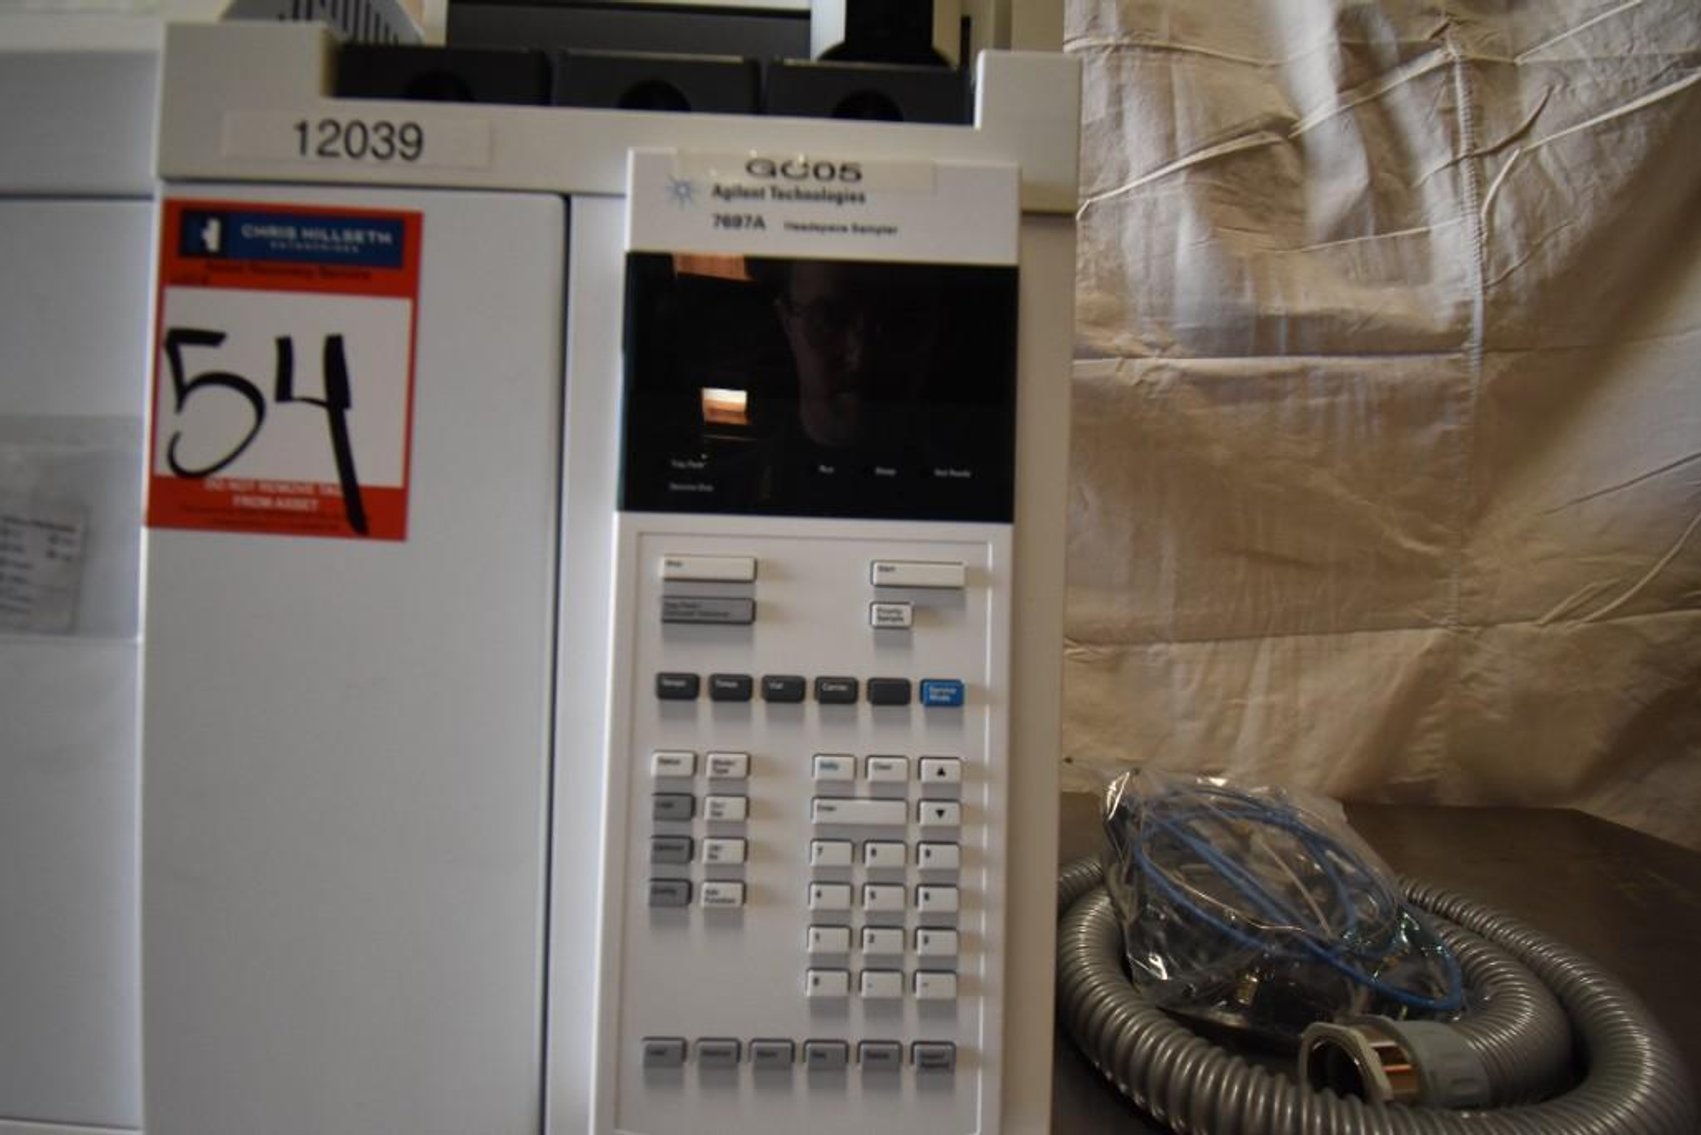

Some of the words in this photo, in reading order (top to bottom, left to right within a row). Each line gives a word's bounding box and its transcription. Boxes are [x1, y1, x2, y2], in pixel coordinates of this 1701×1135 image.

[294, 118, 424, 162] 12039
[745, 157, 863, 183] GC05
[712, 184, 766, 202] Agilent
[770, 186, 867, 205] Technologies
[240, 223, 297, 240] CHRIS
[163, 328, 369, 536] 54
